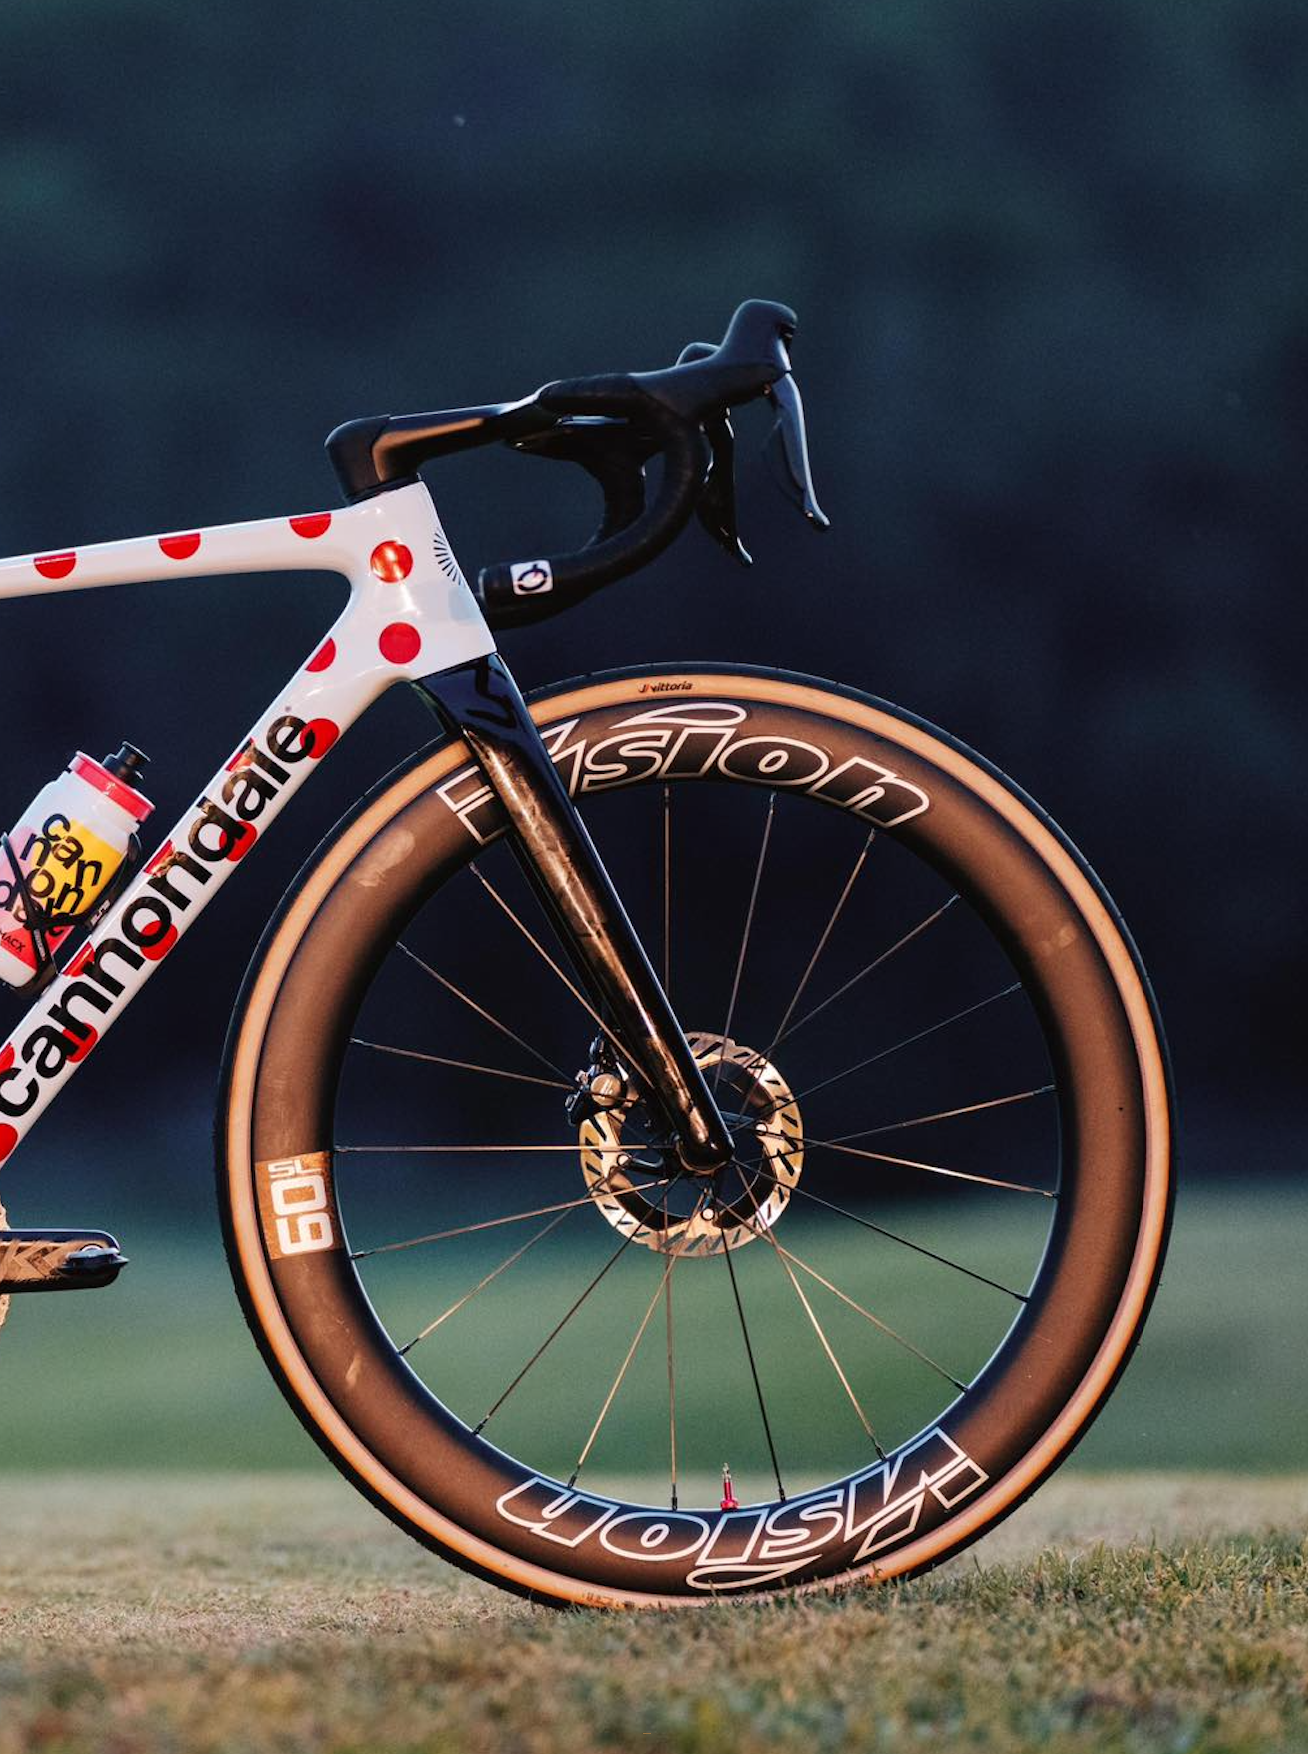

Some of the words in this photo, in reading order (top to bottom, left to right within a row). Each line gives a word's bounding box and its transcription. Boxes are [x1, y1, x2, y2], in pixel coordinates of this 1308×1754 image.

[650, 681, 693, 692] vittoria
[267, 1159, 323, 1179] SL
[270, 1175, 334, 1254] 60
[495, 1426, 989, 1590] Vision
